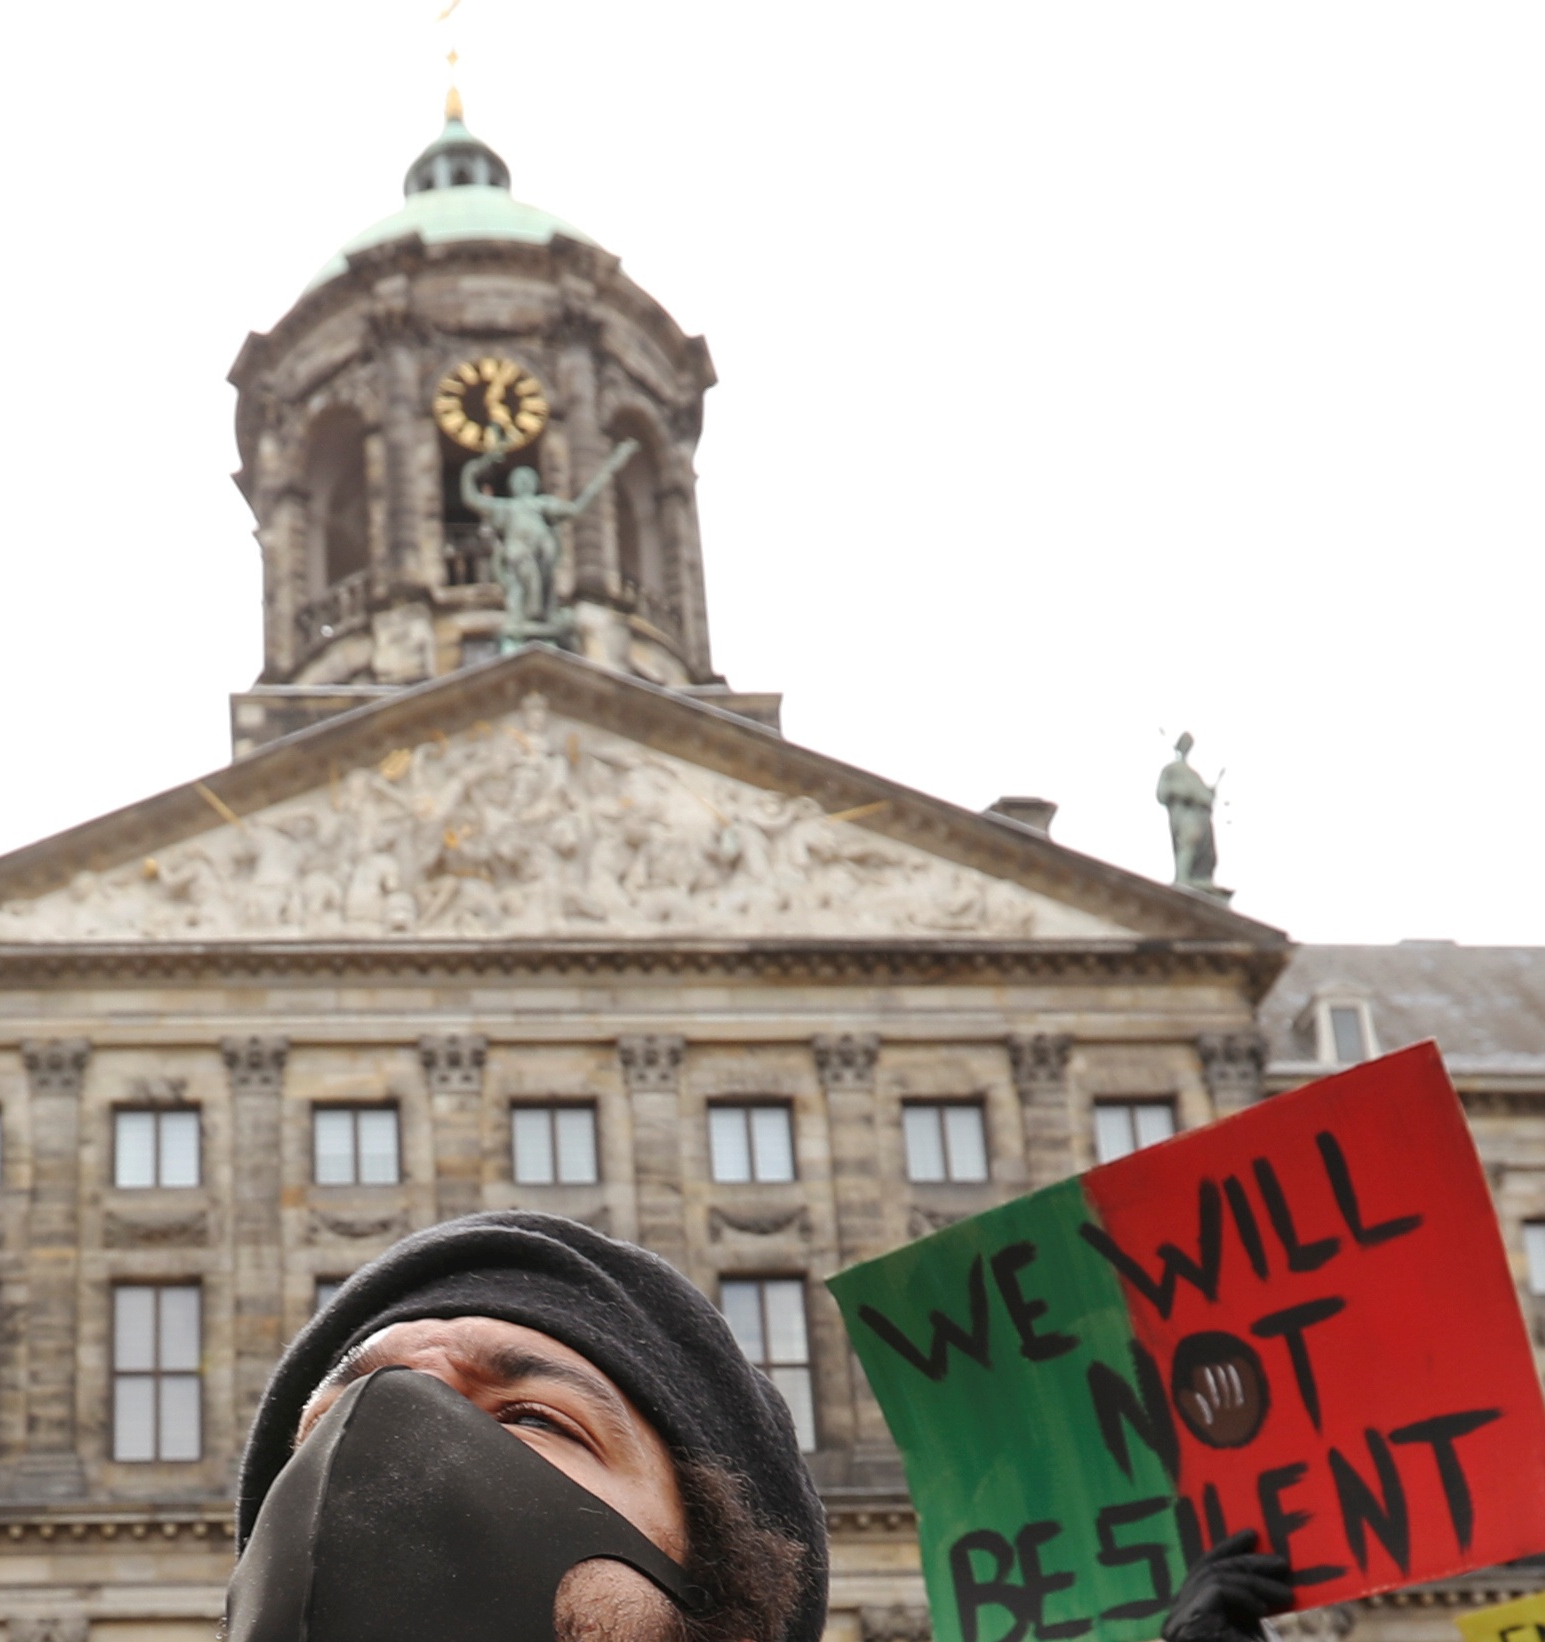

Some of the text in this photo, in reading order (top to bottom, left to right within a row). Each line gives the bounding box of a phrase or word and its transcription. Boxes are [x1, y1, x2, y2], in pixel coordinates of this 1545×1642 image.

[857, 1130, 1425, 1382] WE WILL
[1087, 1296, 1348, 1485] NOT
